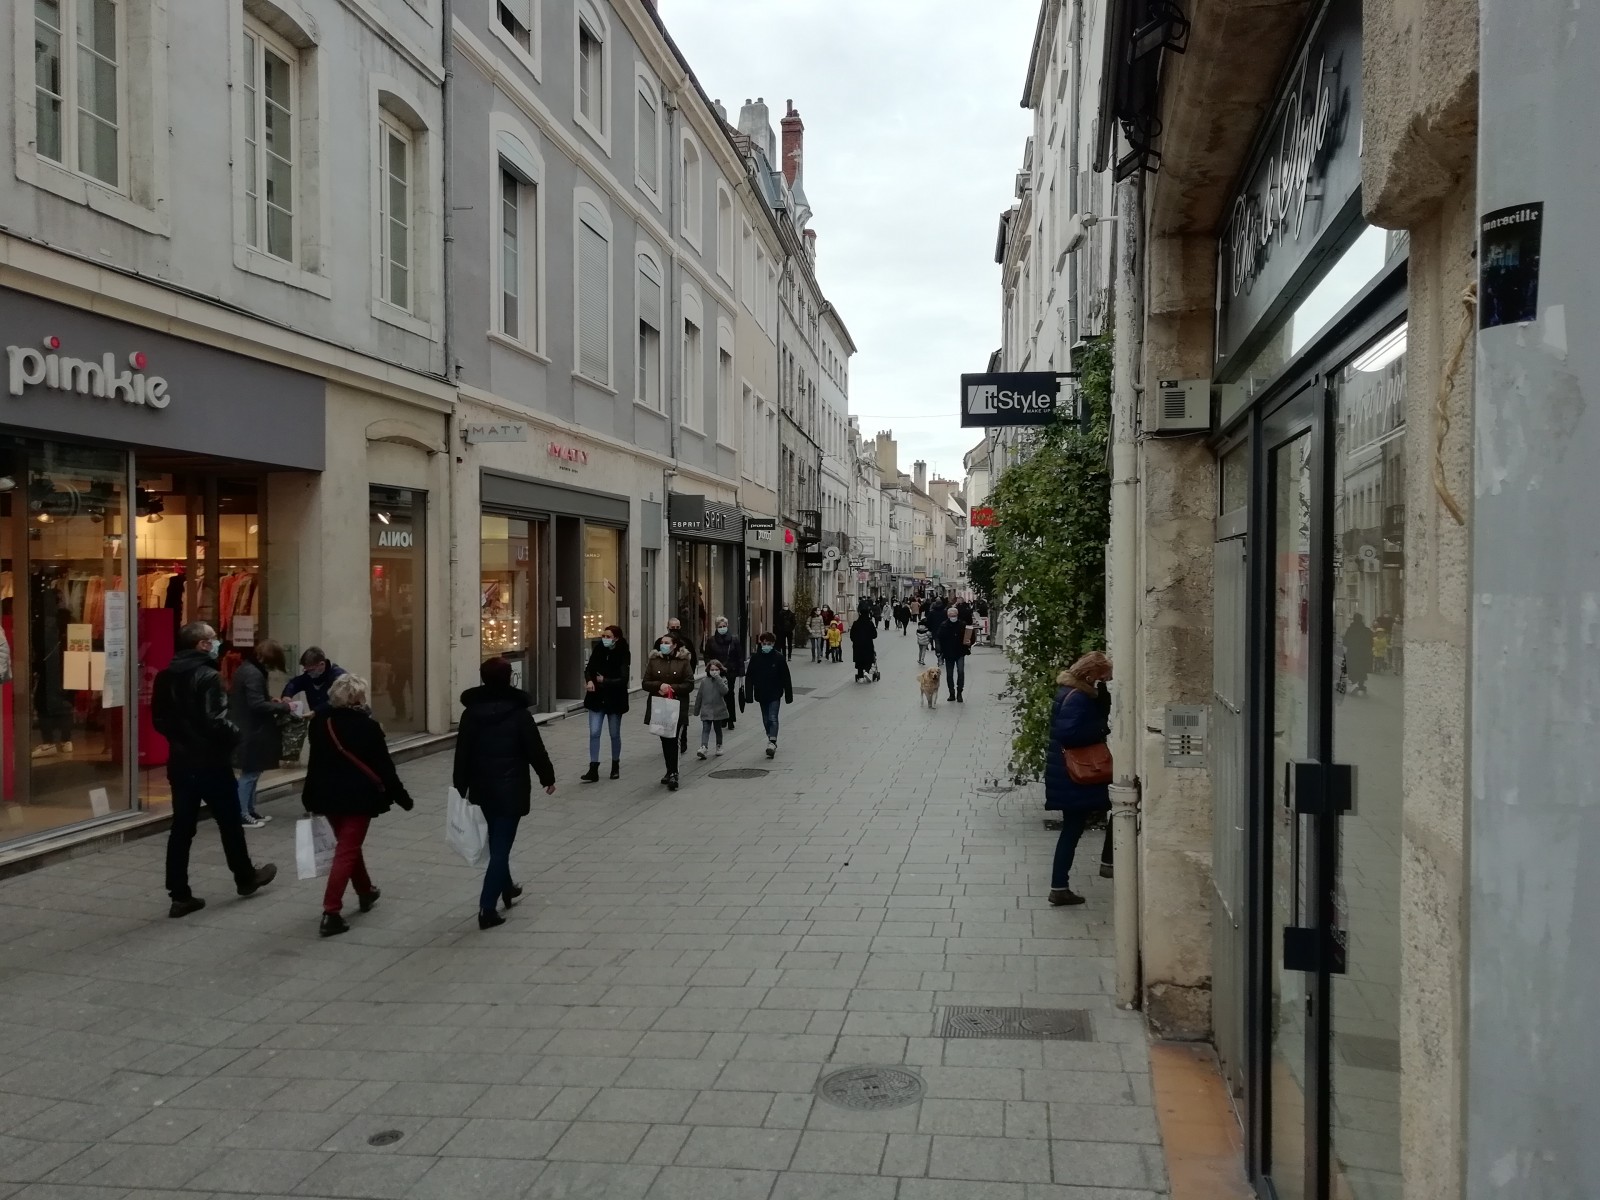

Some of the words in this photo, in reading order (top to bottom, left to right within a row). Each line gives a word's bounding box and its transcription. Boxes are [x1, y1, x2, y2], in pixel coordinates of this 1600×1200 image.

[1482, 208, 1540, 232] marseille
[6, 335, 172, 410] pimkie
[985, 389, 1051, 414] itStyle
[472, 425, 523, 436] MATY
[547, 441, 590, 466] MATY
[704, 510, 728, 530] SPRIT
